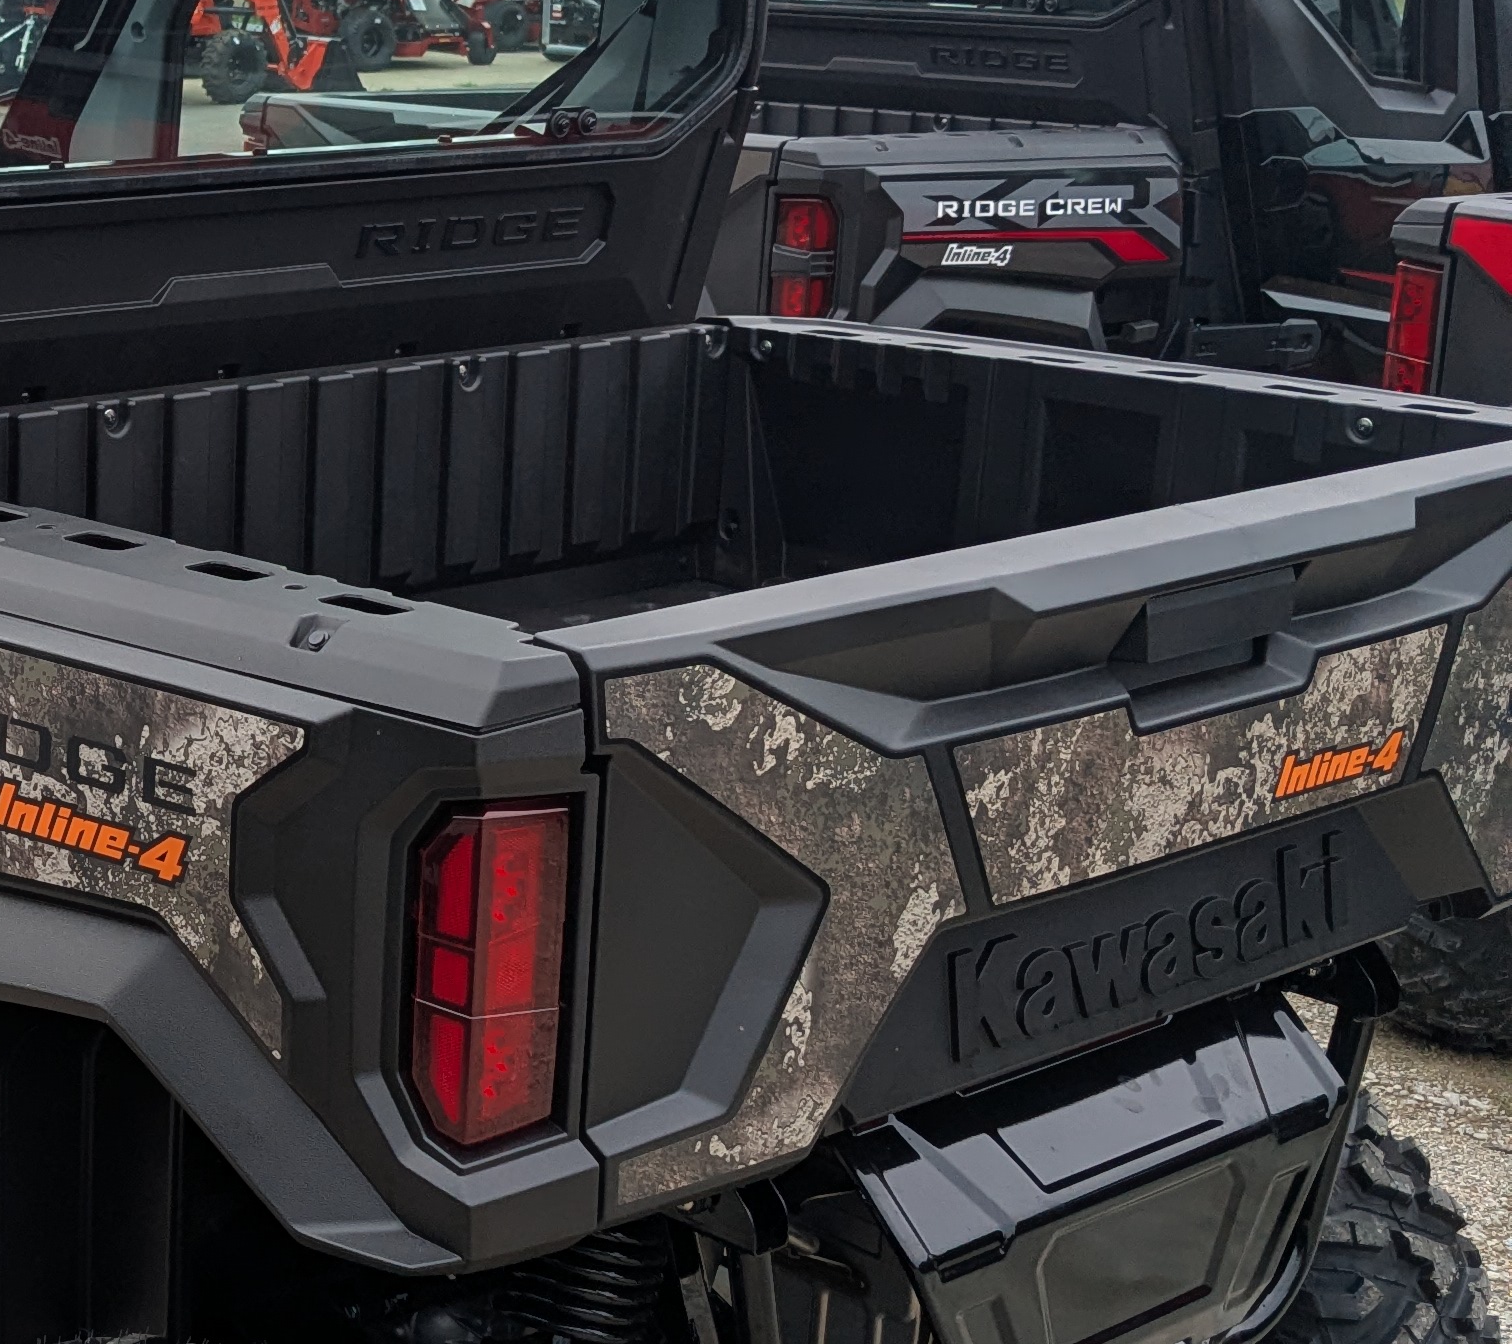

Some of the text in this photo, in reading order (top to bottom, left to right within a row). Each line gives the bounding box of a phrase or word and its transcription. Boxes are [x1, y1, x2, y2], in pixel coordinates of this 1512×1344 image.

[929, 45, 1071, 74] RIDGE
[937, 197, 1123, 219] RIDGE CREW
[354, 205, 586, 259] RIDGE
[941, 243, 1014, 266] Inline-4
[1273, 729, 1409, 803] Inline-4
[947, 830, 1354, 1062] Kawasaki
